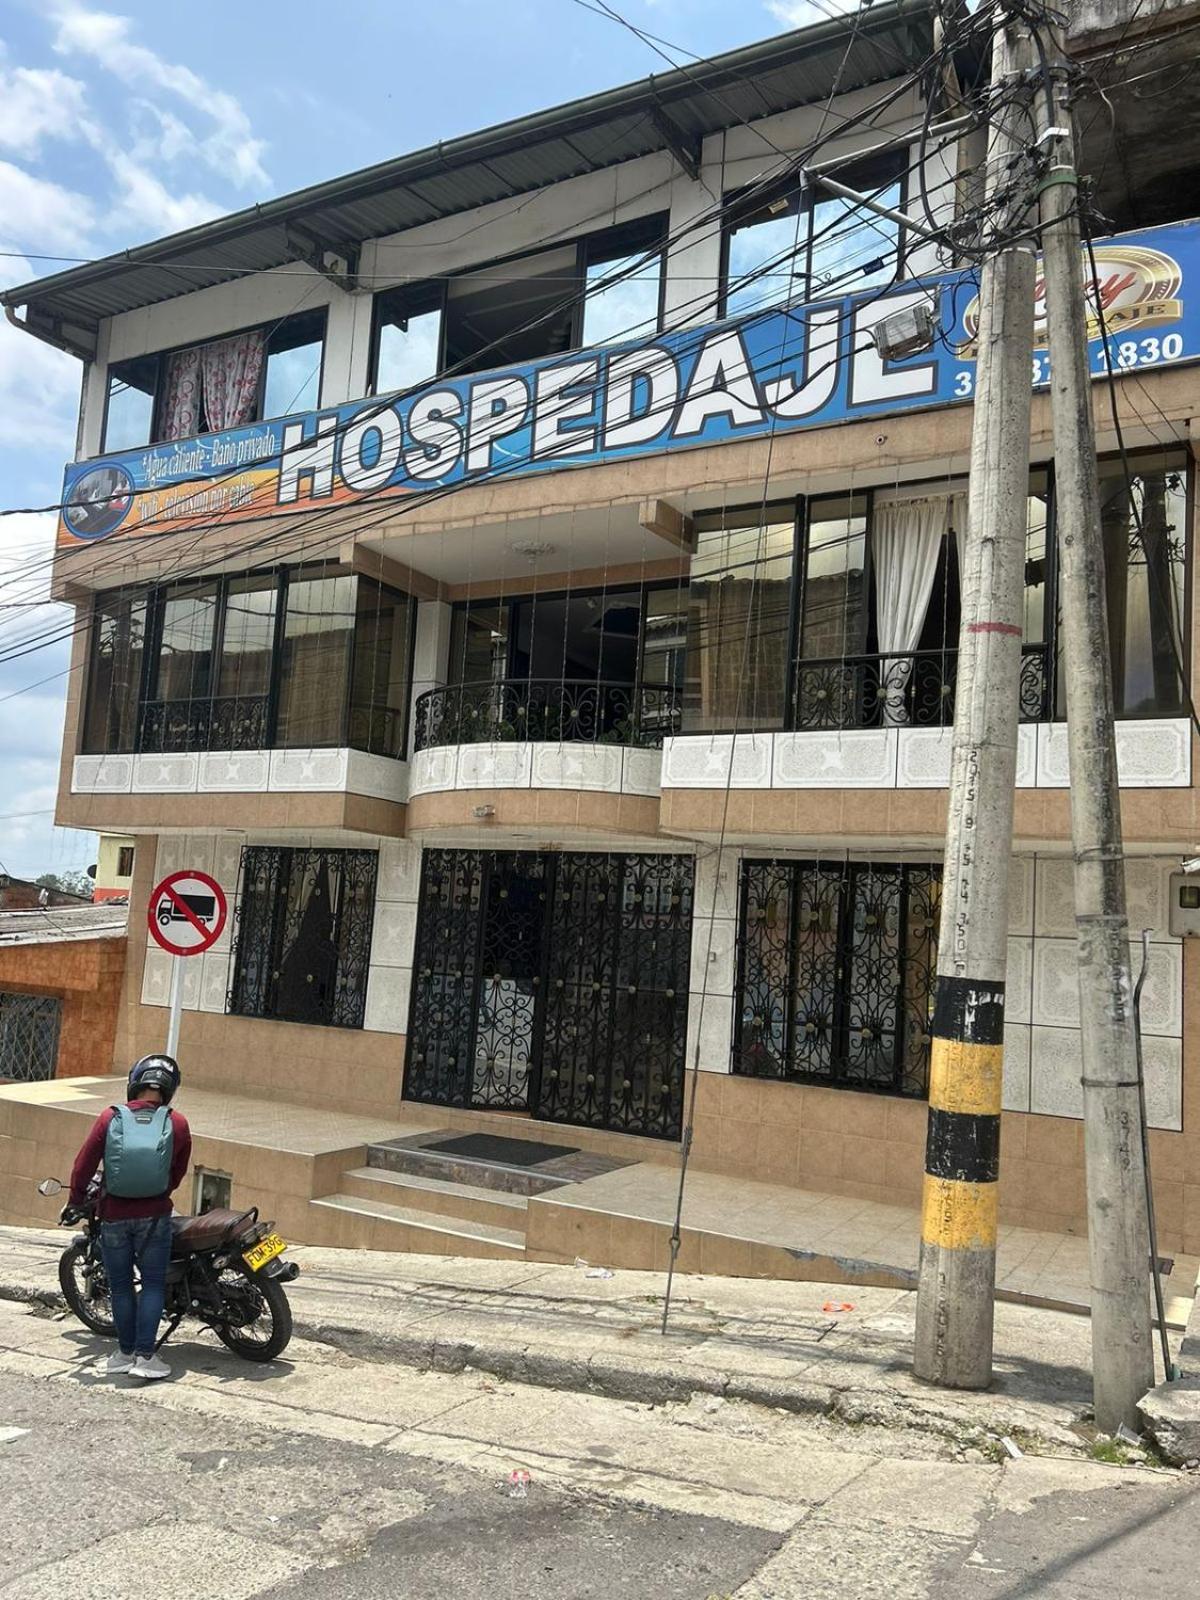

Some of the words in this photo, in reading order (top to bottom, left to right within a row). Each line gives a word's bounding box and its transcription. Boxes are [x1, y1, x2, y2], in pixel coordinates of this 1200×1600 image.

[1097, 334, 1183, 371] 1830
[277, 287, 937, 503] HOSPEDAJE
[168, 445, 206, 477] caliente
[237, 427, 275, 466] privado
